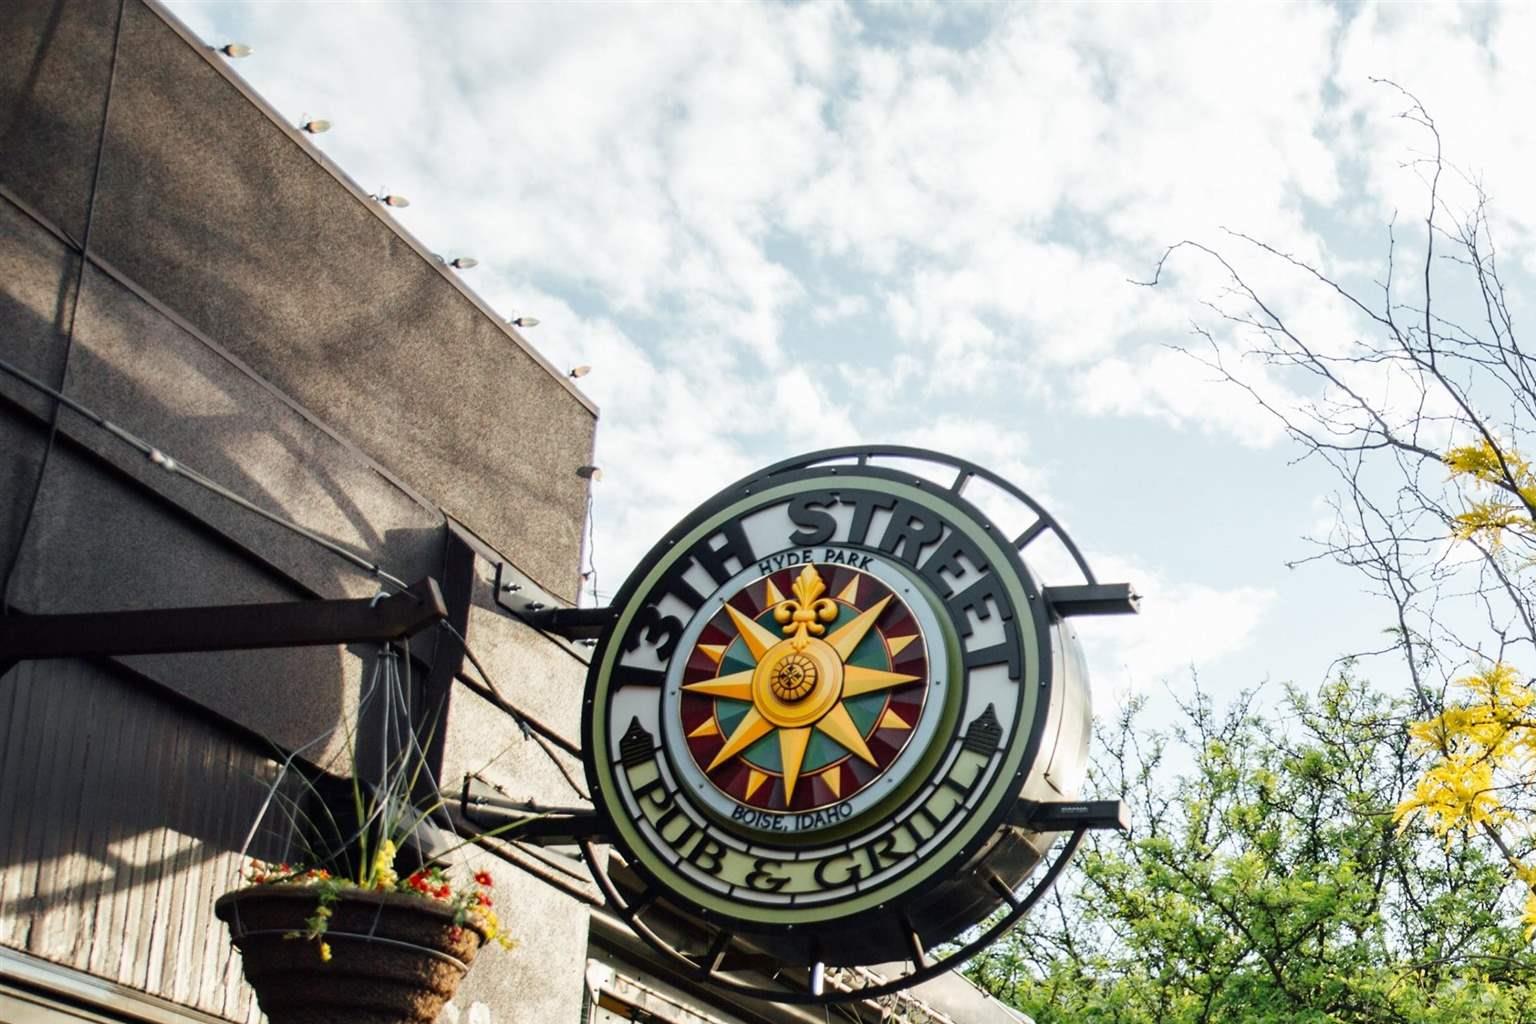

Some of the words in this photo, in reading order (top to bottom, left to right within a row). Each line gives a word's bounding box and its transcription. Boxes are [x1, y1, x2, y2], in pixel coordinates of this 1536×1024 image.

[613, 519, 758, 692] 13TH
[787, 494, 1021, 681] STREET
[758, 549, 815, 576] HYDE
[824, 549, 875, 571] PARK
[633, 775, 728, 877] PUB
[745, 859, 792, 892] &
[814, 763, 985, 889] GRILL
[731, 804, 789, 832] BOISE,
[795, 802, 853, 830] IDAHO
